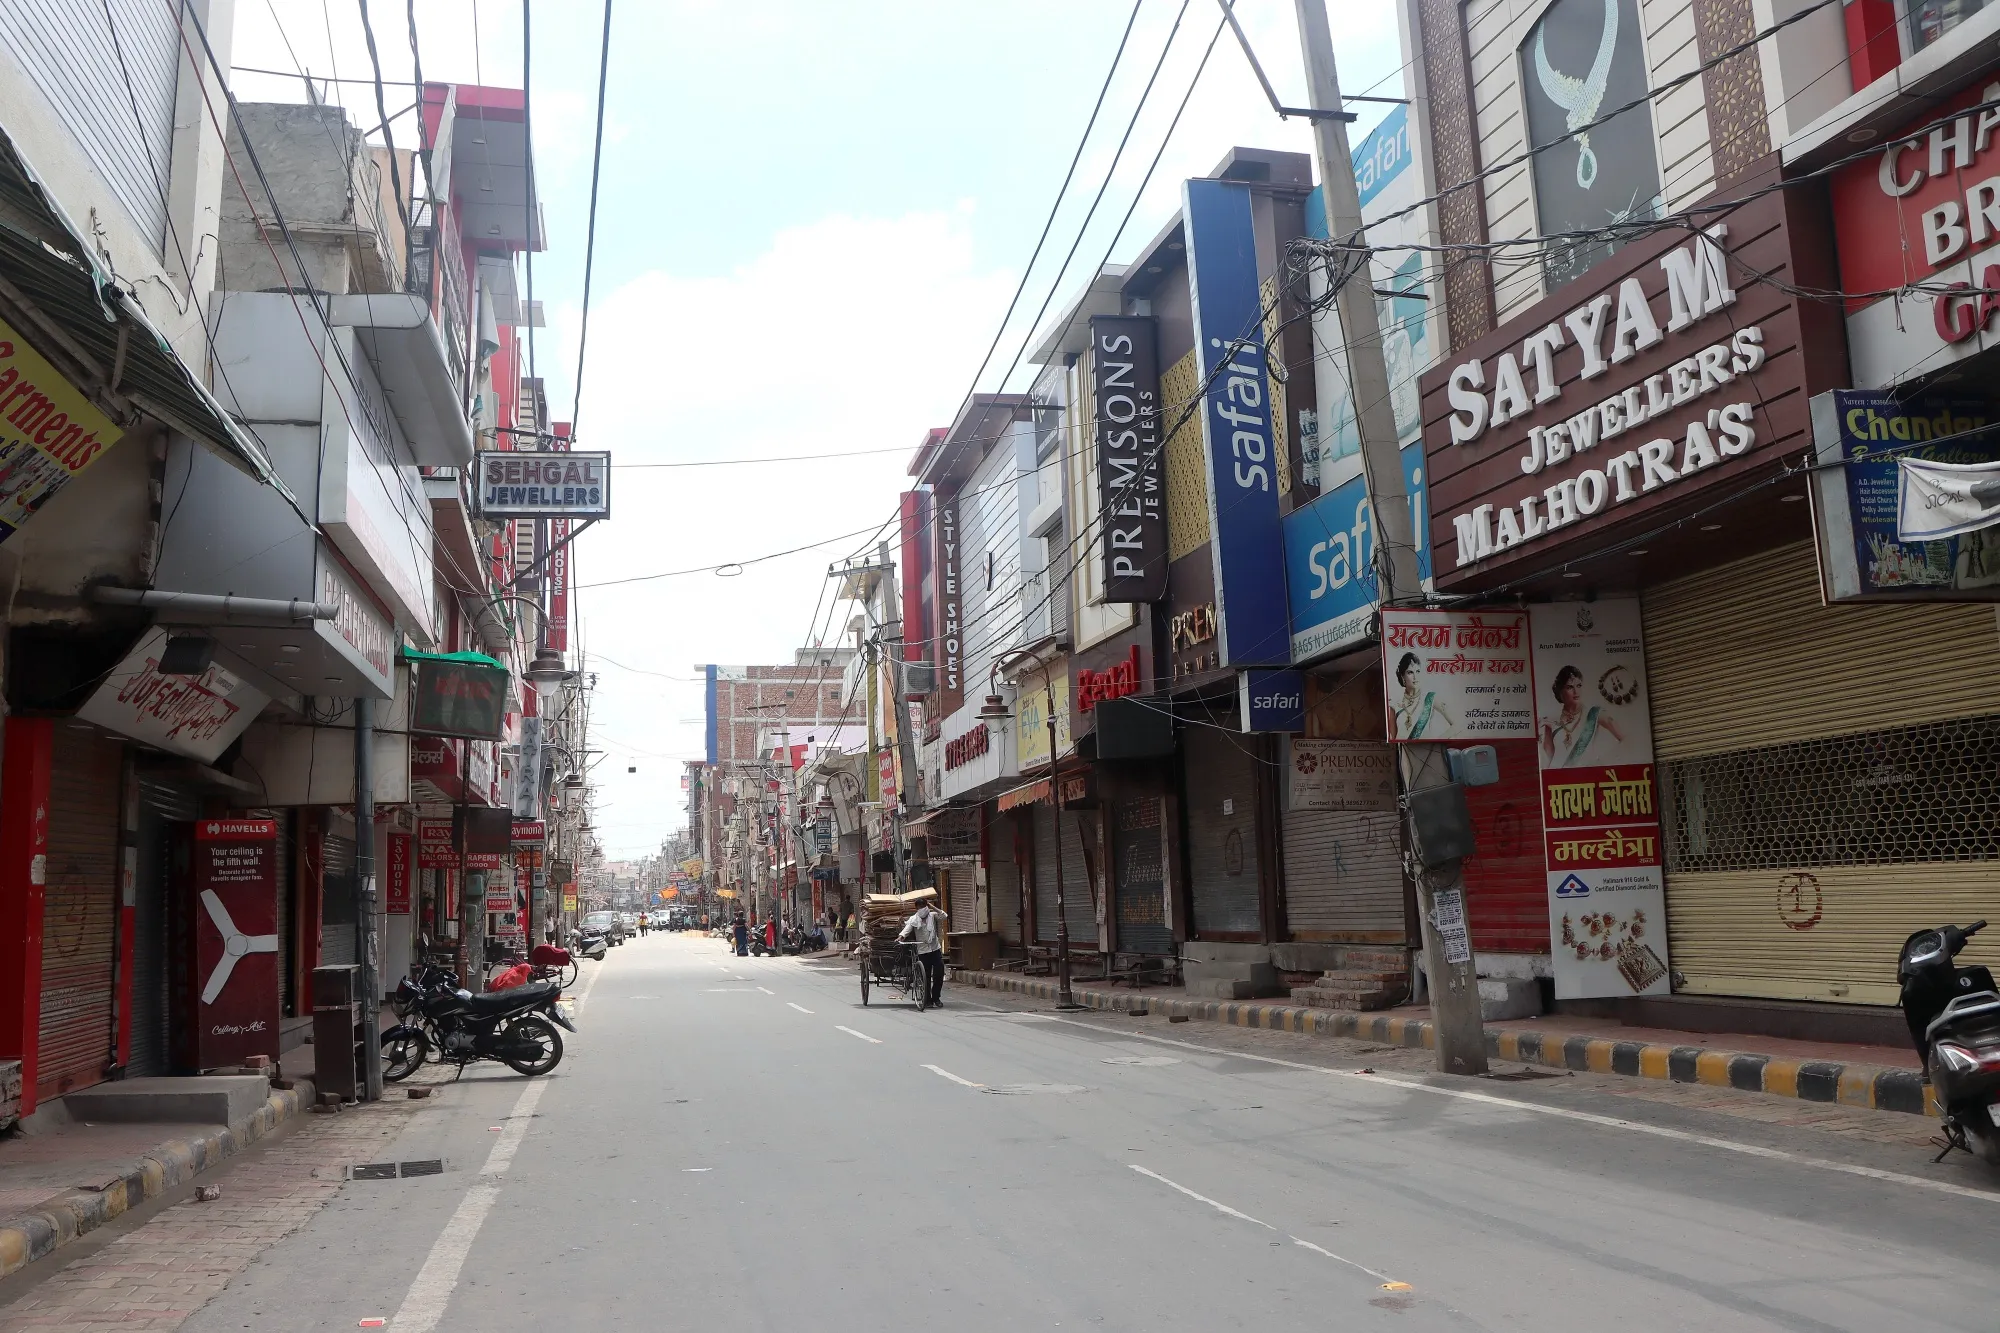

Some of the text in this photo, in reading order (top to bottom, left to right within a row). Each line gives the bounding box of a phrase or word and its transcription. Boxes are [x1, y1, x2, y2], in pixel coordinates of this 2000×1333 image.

[1448, 223, 1737, 446] SATYAM
[1520, 326, 1766, 475] JEWELLERS
[1211, 336, 1269, 491] safari
[1846, 408, 1986, 441] Chander
[1102, 334, 1145, 578] PREMSONS
[1139, 390, 1160, 520] JEWELLERS
[486, 460, 599, 485] SEHGAL
[1452, 402, 1756, 567] MALHOTRA'S
[1870, 478, 1895, 487] Jewellery
[486, 486, 600, 506] JEWELLERS
[1860, 496, 1876, 504] Bridal
[553, 552, 564, 596] HOUSE
[943, 509, 959, 690] STYLE SHOES
[1292, 634, 1313, 657] BAGS
[1321, 617, 1362, 647] LUGGAGE
[1388, 616, 1523, 649] सत्यम ज्वैलर्स
[1077, 644, 1141, 713] Regal
[1488, 659, 1525, 674] सन्स
[1253, 692, 1299, 709] safari
[518, 718, 540, 817] NATRAJ
[1320, 754, 1392, 767] PREMSONS
[1548, 783, 1597, 820] सत्यम
[222, 824, 269, 833] HAVELLS
[511, 825, 543, 838] aymond
[210, 846, 263, 858] Your ceiling is
[212, 856, 261, 867] the fifth wall.
[466, 854, 497, 862] RAPERS
[230, 874, 251, 882] designer
[392, 837, 405, 898] Raymond
[841, 877, 871, 885] BAA
[1615, 884, 1637, 892] Diamond
[1636, 884, 1659, 892] Jewellery
[211, 1020, 266, 1036] Ceiling Art
